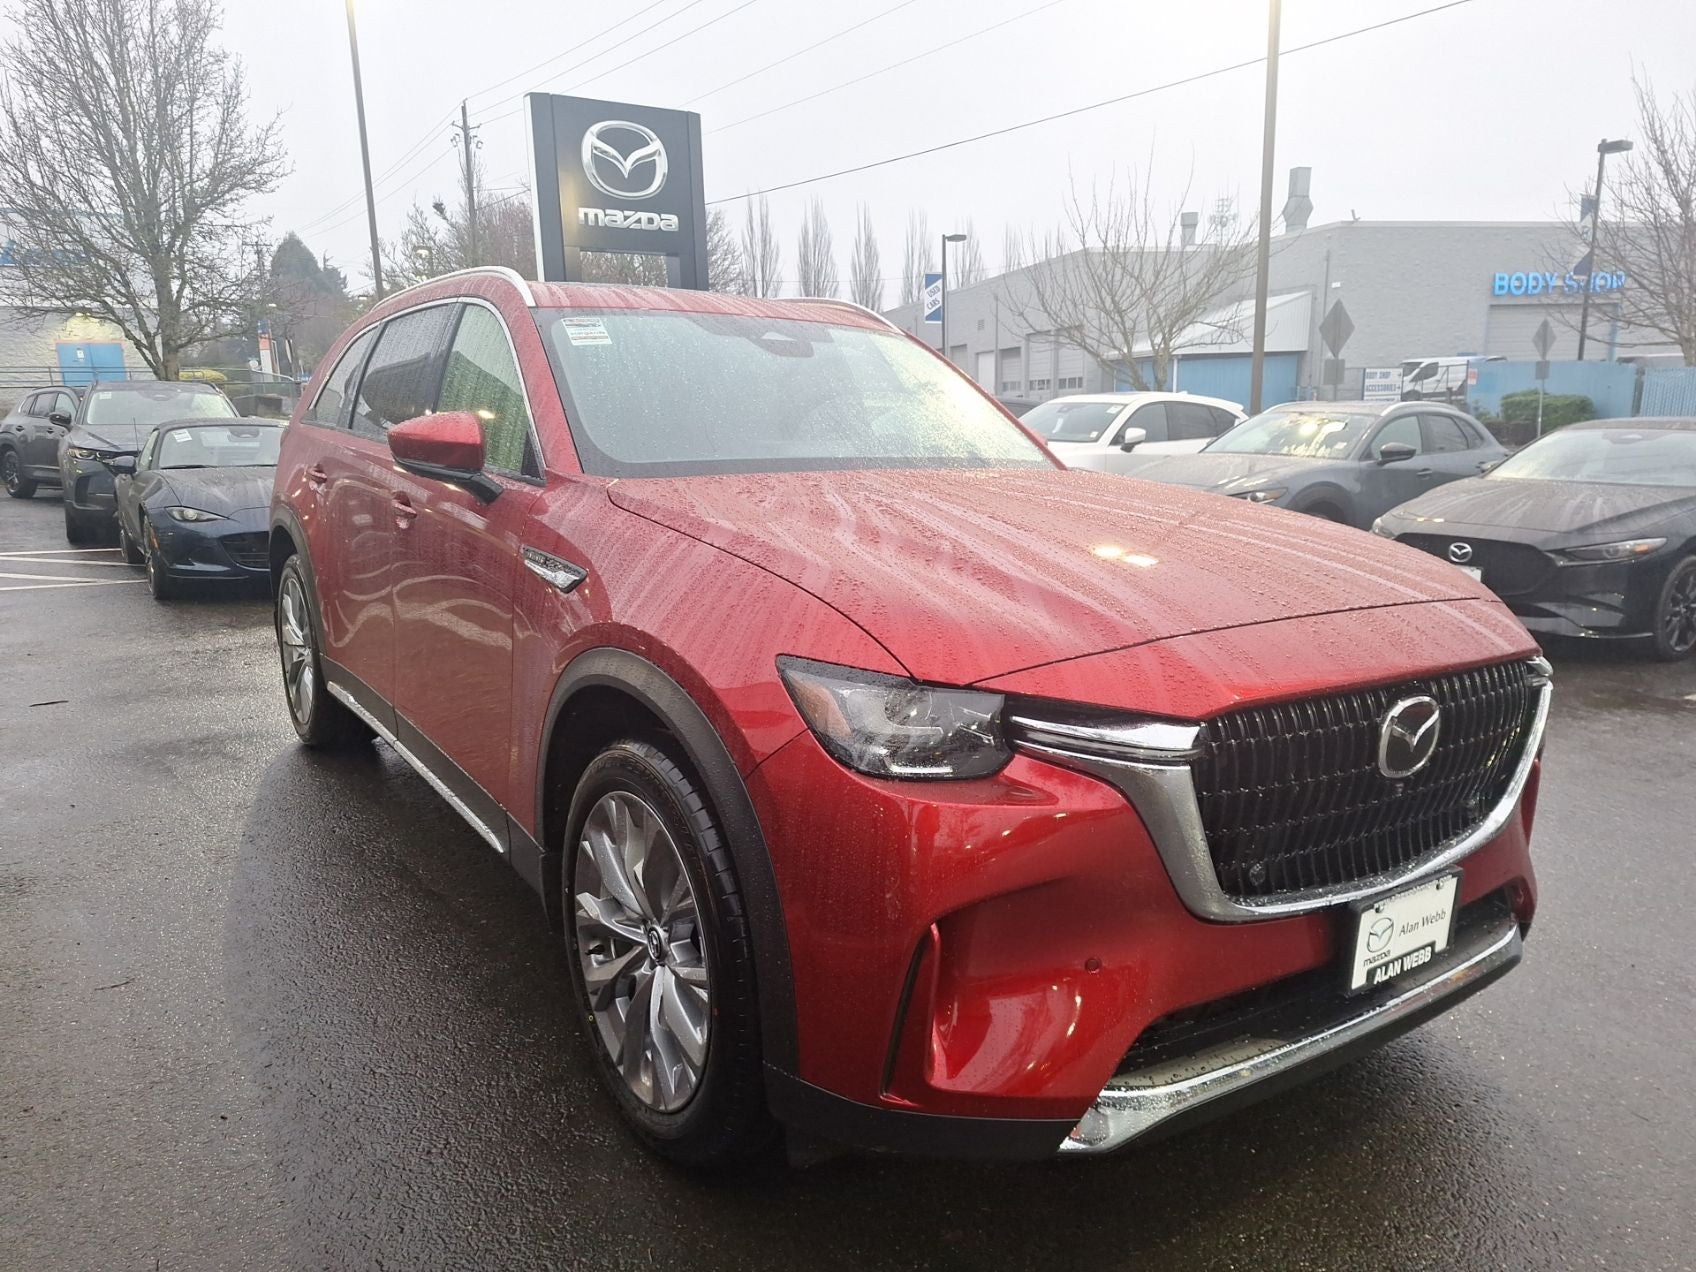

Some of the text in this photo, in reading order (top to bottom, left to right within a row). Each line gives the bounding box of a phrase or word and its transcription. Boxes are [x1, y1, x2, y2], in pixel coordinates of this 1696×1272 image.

[926, 285, 941, 298] USED
[1494, 271, 1558, 297] BODY
[926, 298, 941, 310] CARS
[1398, 908, 1447, 937] Alan Webb
[1373, 946, 1432, 985] ALAN WEBB
